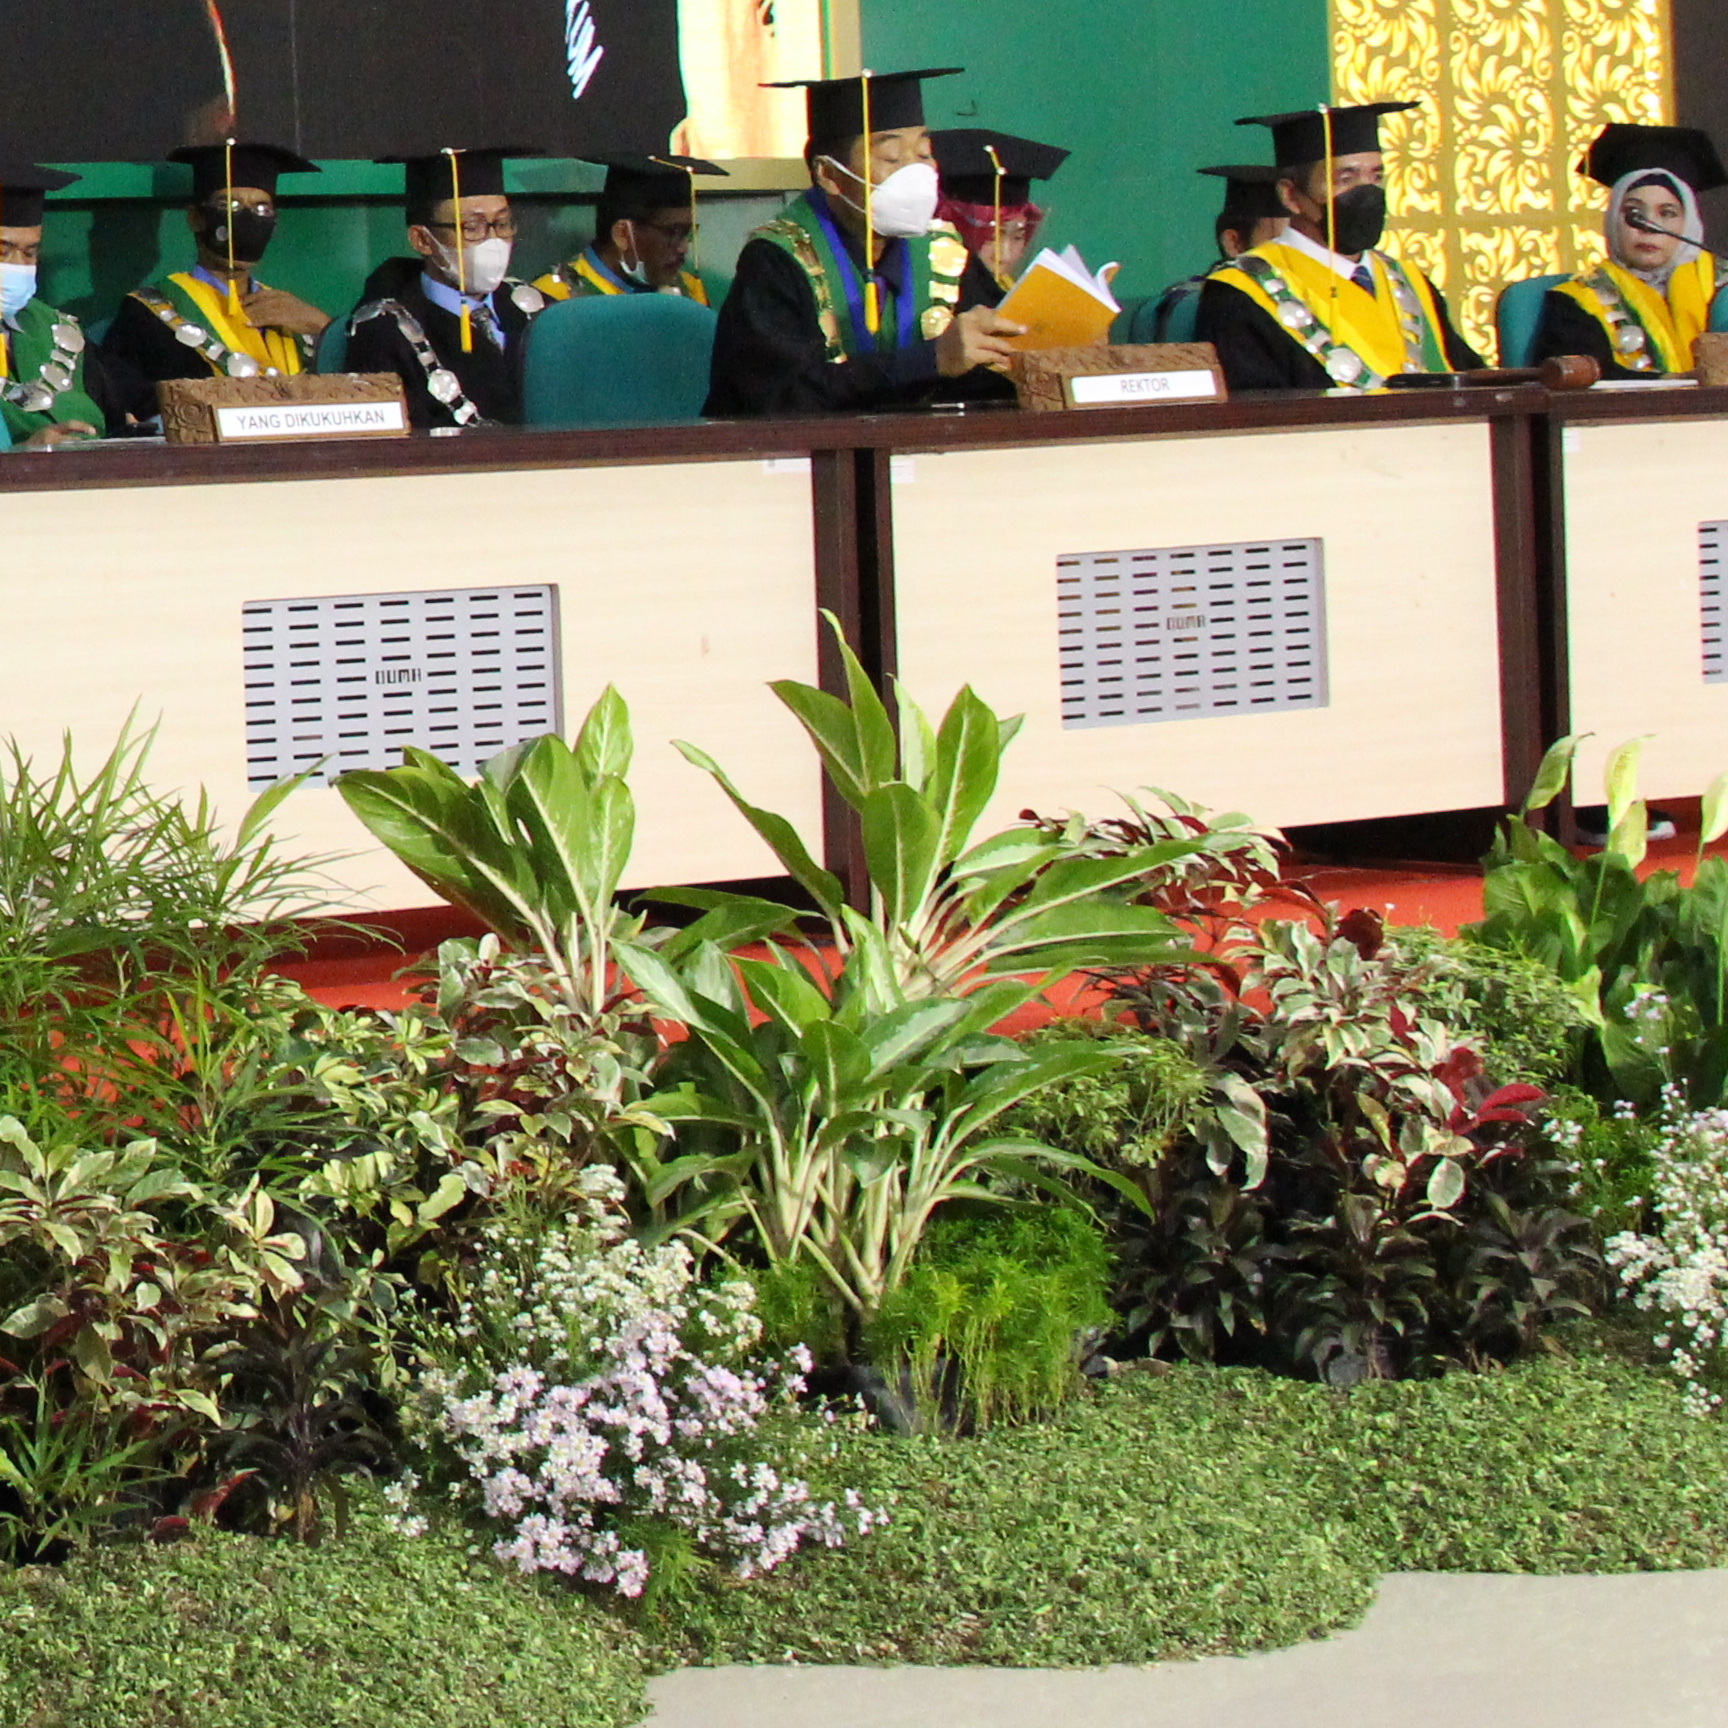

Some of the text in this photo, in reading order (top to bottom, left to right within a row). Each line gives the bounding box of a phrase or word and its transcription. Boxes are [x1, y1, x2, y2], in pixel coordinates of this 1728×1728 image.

[1119, 377, 1171, 394] REKTOR
[236, 409, 386, 431] YANG DIKUKUHKAN
